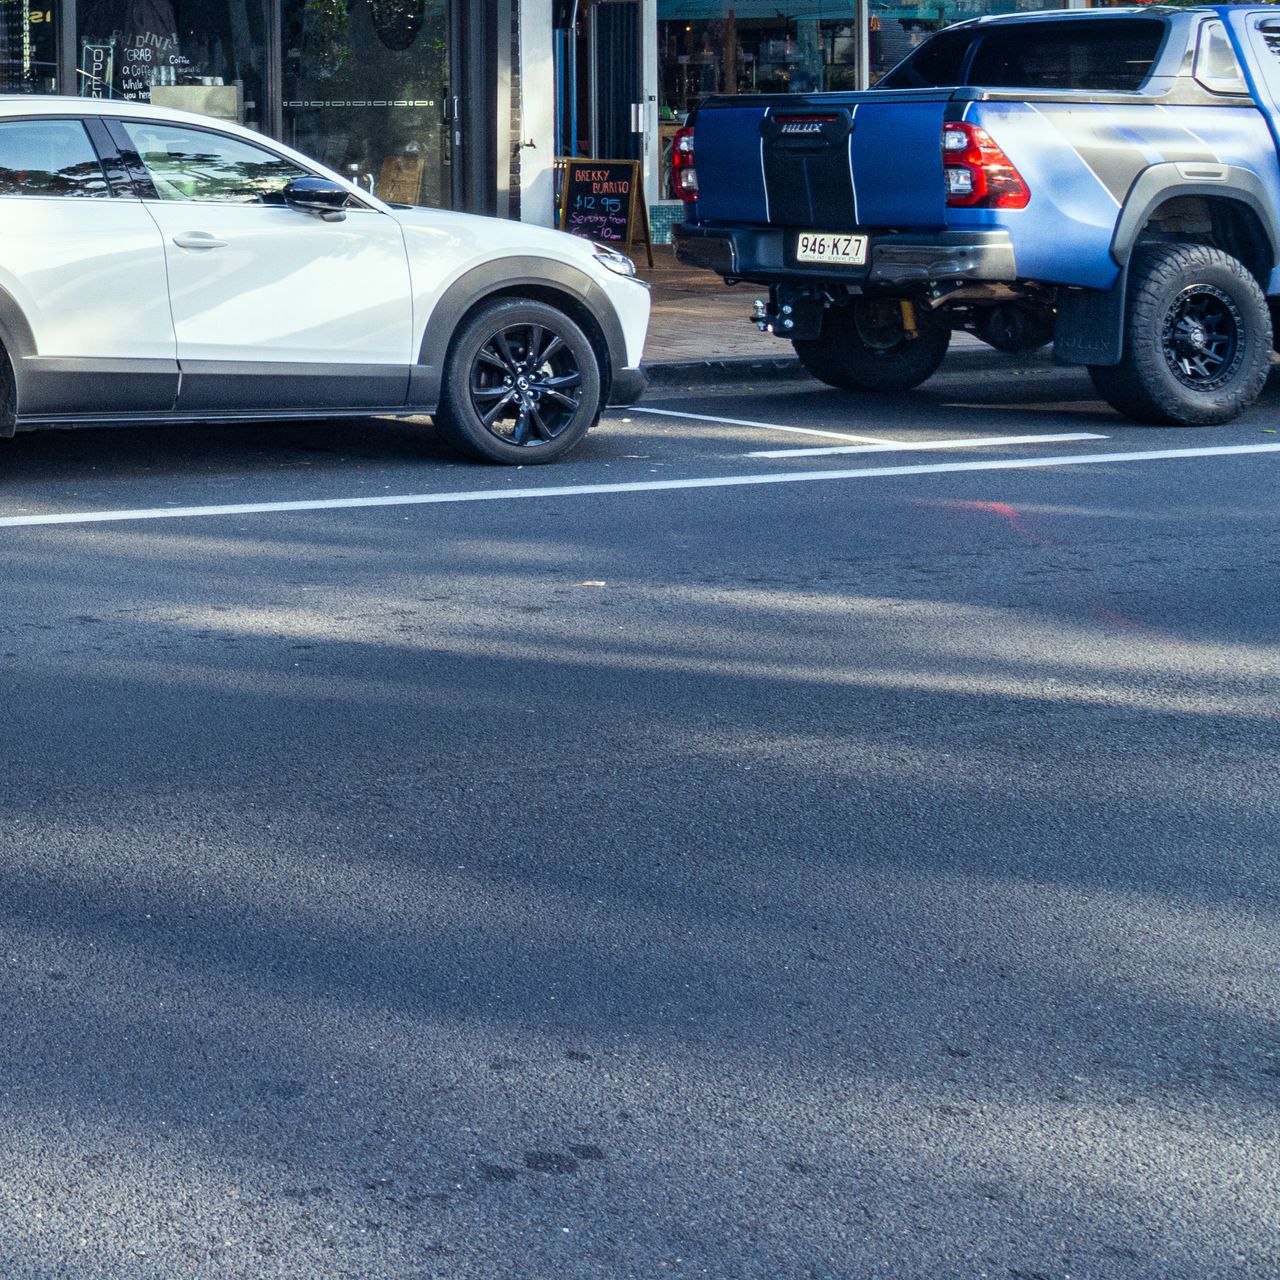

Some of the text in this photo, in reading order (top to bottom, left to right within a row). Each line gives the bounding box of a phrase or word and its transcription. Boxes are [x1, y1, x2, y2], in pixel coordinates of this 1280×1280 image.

[781, 123, 823, 133] HILUX
[575, 169, 610, 182] BREKKY
[592, 181, 629, 194] BURRITO
[569, 212, 608, 228] Serving
